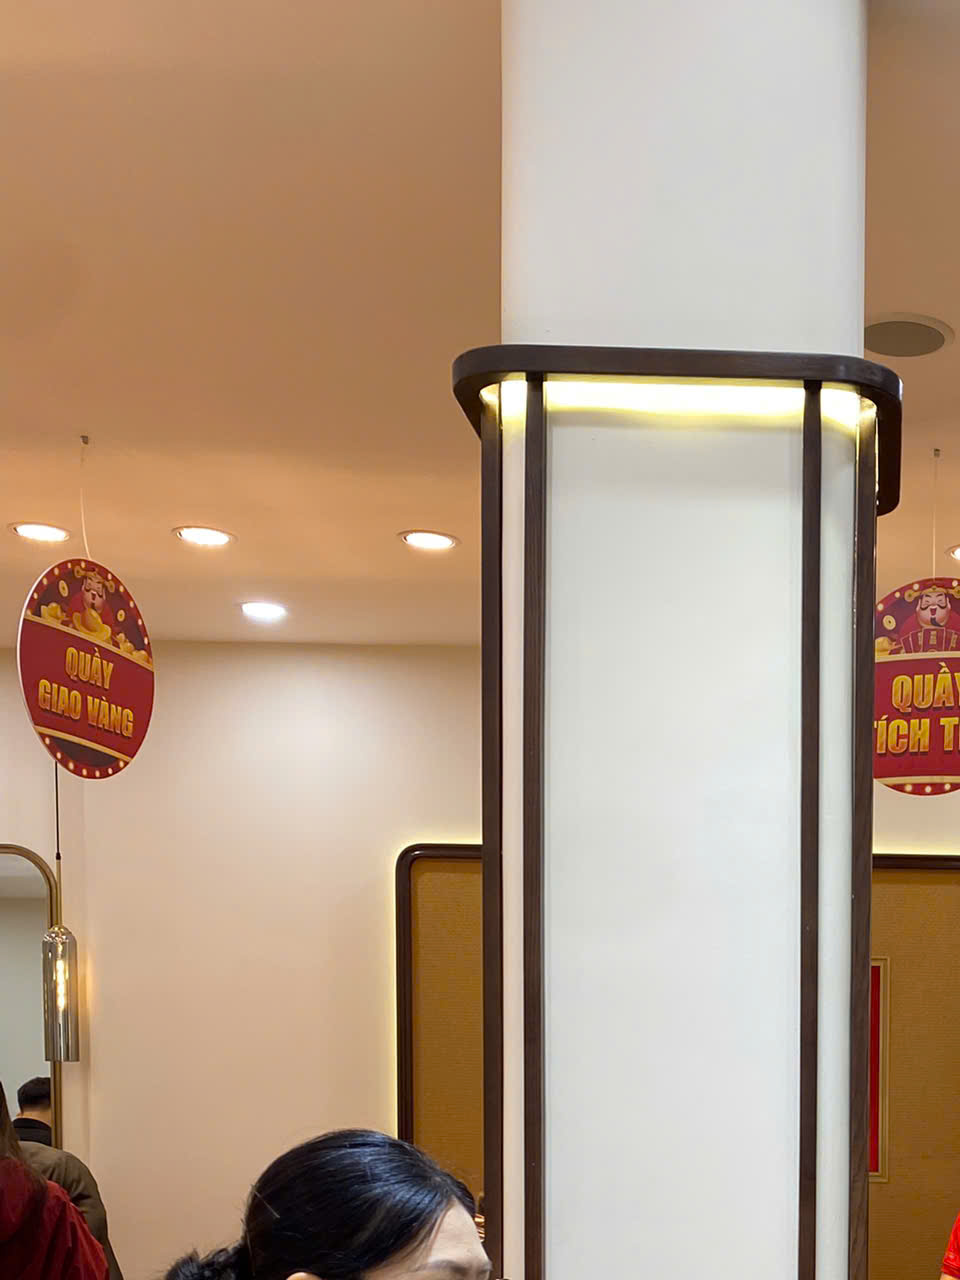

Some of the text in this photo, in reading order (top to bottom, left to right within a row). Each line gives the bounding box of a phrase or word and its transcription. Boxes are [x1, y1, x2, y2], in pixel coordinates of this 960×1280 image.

[65, 647, 114, 690] QUẦY
[38, 679, 134, 738] GIAO VÀNG
[873, 715, 930, 754] ÍCH
